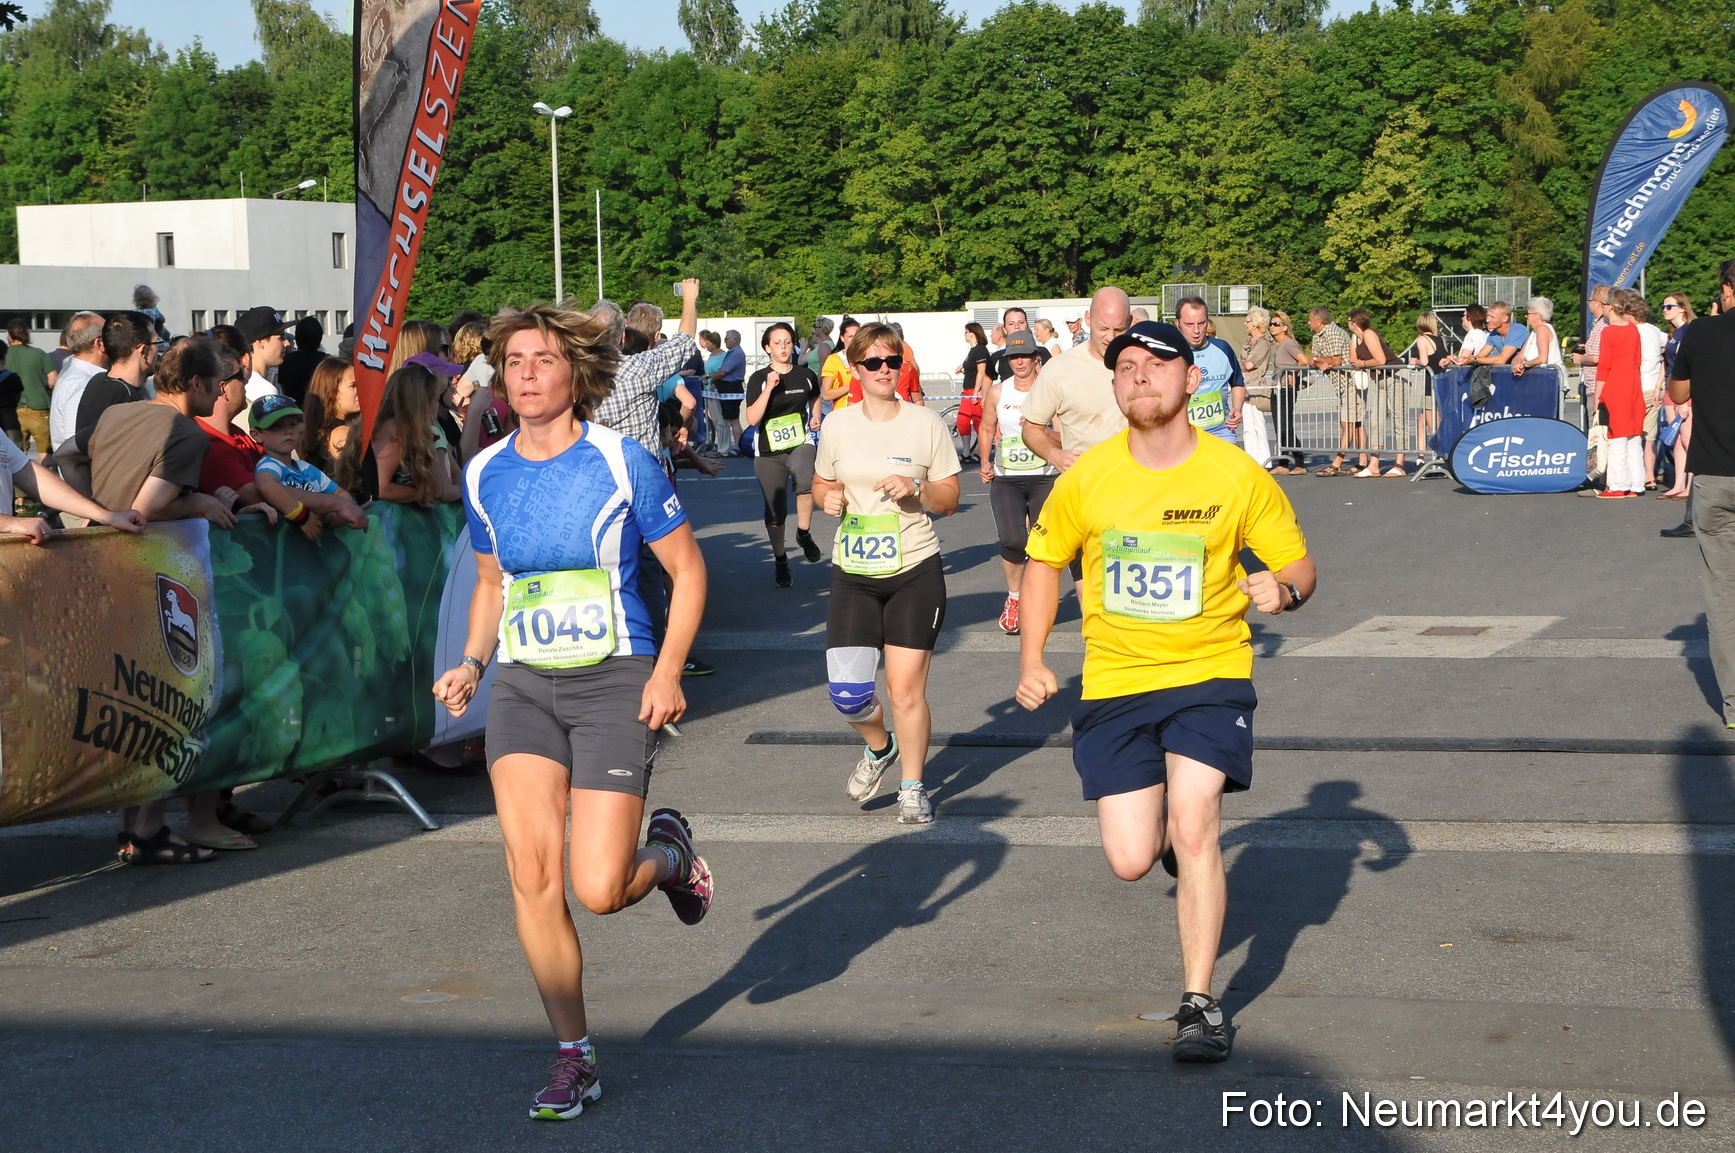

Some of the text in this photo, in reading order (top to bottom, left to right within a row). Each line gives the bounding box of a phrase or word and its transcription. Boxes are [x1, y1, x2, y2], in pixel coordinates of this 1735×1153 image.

[1660, 161, 1685, 192] Druck
[1595, 142, 1690, 259] Frischmann
[1188, 402, 1222, 420] 1204
[773, 425, 797, 442] 981
[1487, 450, 1577, 468] Fischer
[1496, 467, 1570, 478] AUTOMOBILE
[1162, 509, 1202, 520] swn
[841, 535, 897, 559] 1423
[1106, 561, 1192, 601] 1351
[508, 604, 608, 646] 1043
[558, 645, 583, 653] Zaschka
